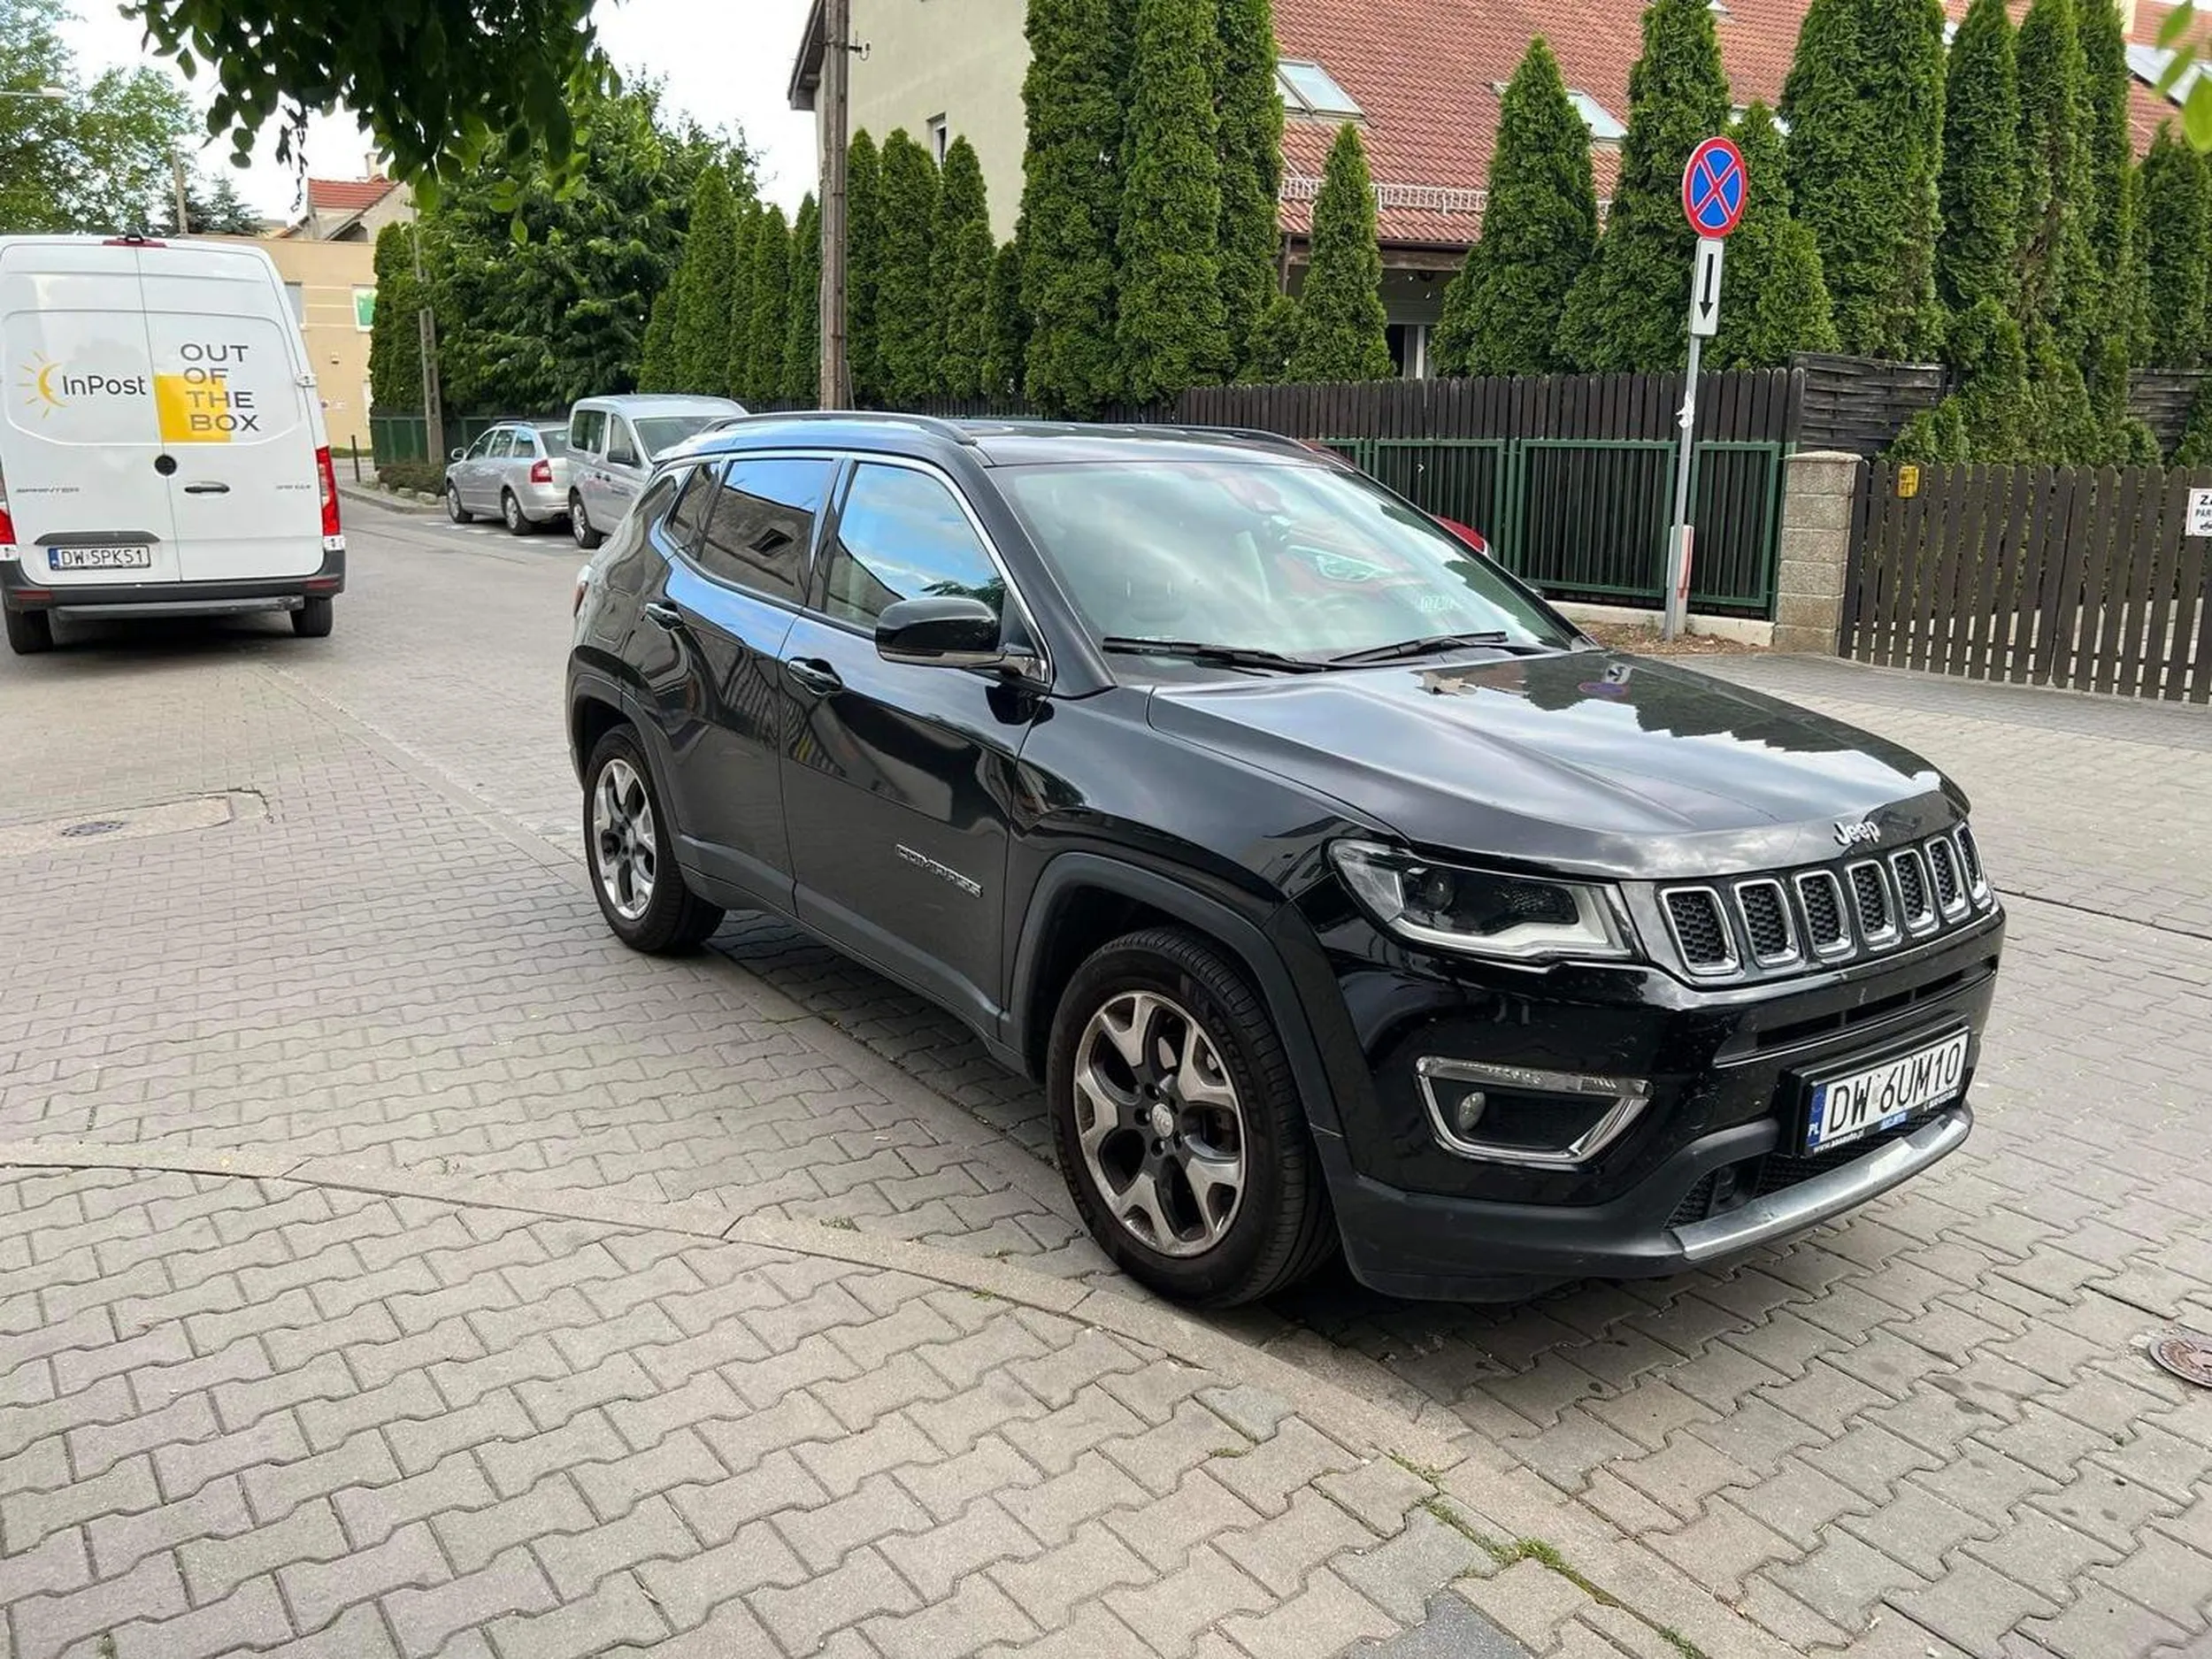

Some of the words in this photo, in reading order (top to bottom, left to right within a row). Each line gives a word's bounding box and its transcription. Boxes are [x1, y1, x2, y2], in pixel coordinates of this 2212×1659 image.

[180, 343, 249, 362] OUT
[63, 374, 146, 396] InPost
[184, 367, 228, 385] OF
[186, 391, 255, 408] THE
[190, 414, 261, 432] BOX
[61, 550, 84, 565] DW
[1833, 821, 1881, 845] Jeep
[1829, 1075, 1872, 1133] DW
[1879, 1042, 1961, 1113] 6UM10
[1808, 1122, 1820, 1137] PL
